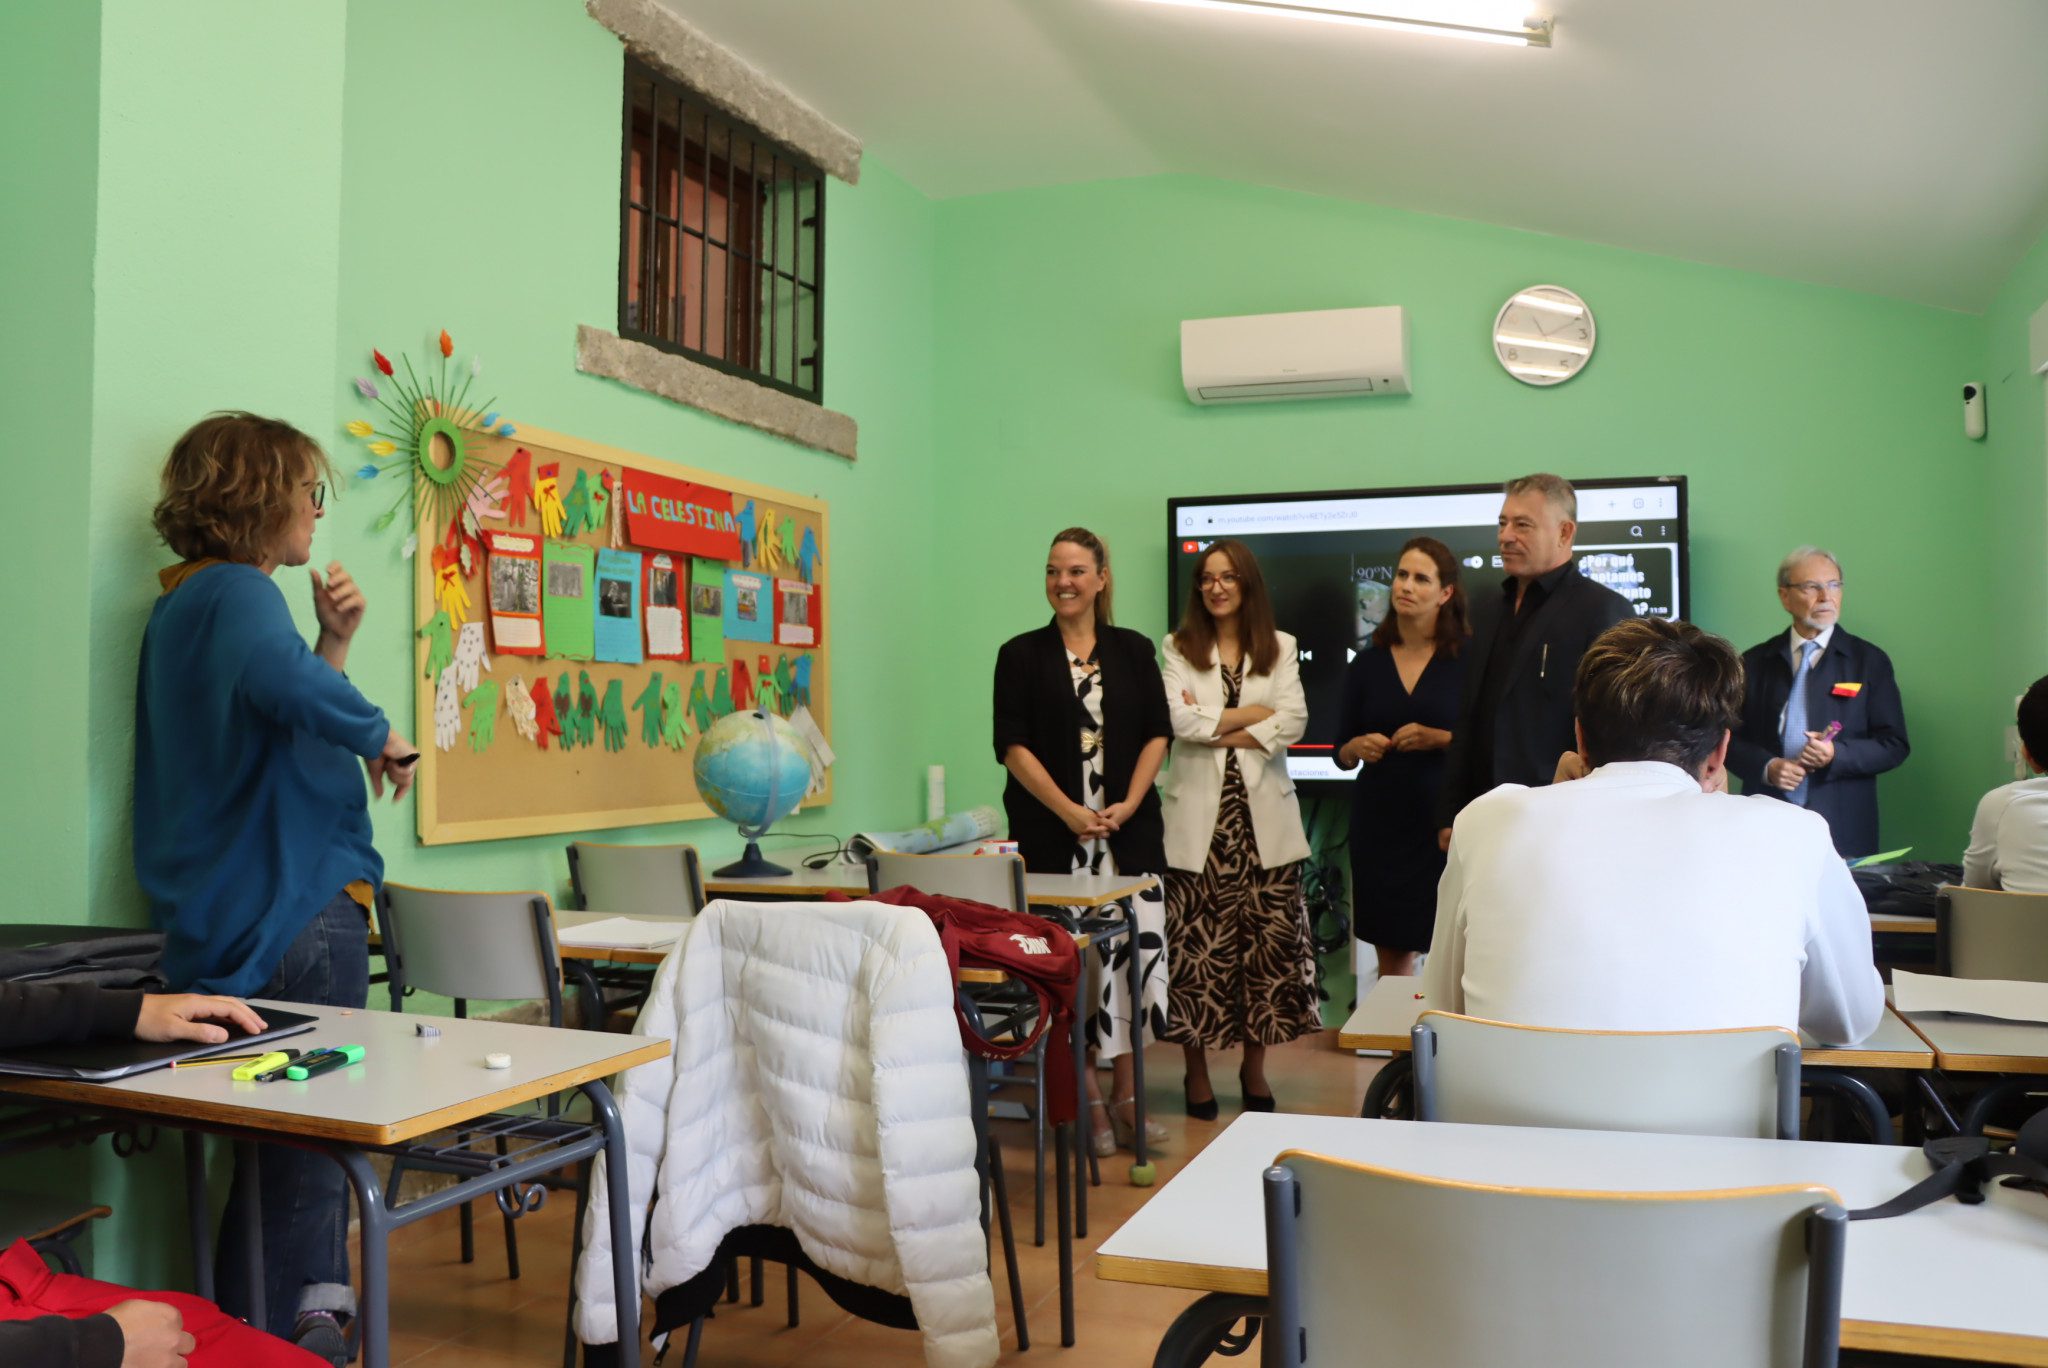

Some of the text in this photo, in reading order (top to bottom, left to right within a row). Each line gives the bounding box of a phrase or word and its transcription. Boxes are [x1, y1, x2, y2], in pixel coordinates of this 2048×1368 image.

[1578, 328, 1588, 340] 3
[1507, 350, 1518, 361] 8
[627, 489, 736, 533] LA CELESTINA
[1290, 769, 1329, 777] staciones
